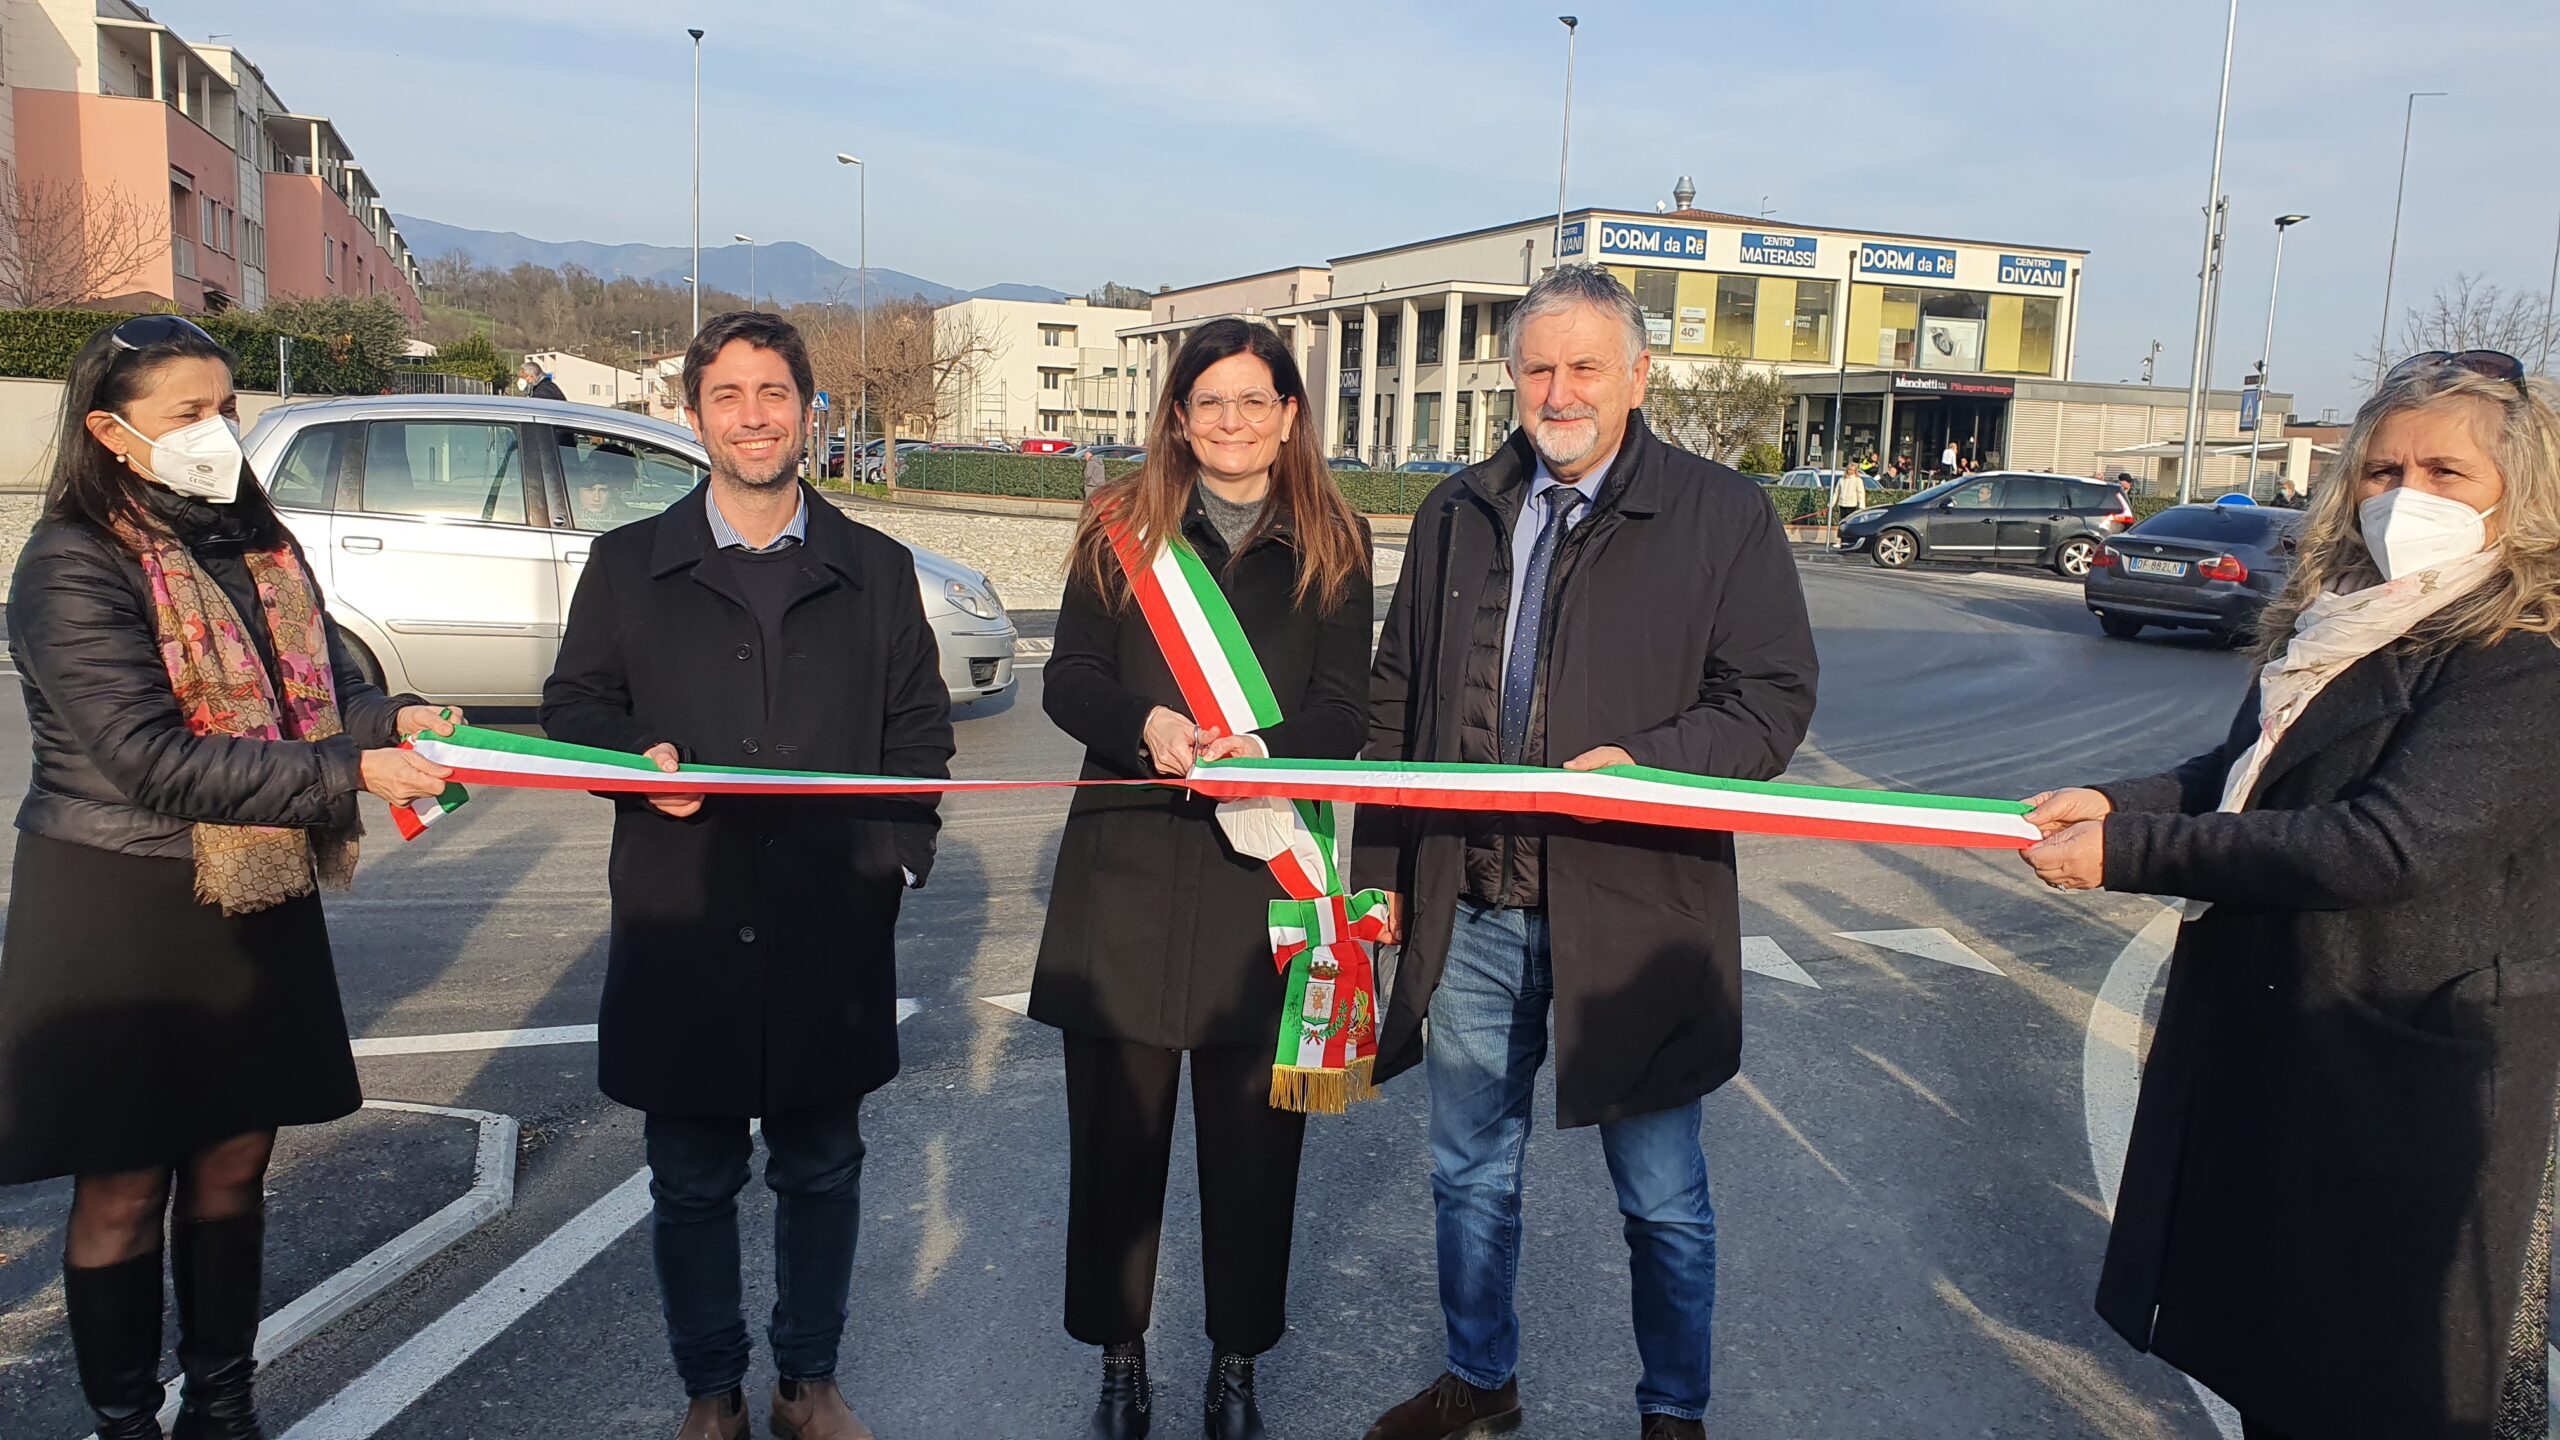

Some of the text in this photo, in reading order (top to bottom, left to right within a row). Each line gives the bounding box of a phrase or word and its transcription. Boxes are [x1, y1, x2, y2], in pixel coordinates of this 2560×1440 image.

[1602, 228, 1660, 251] DORMI
[1664, 237, 1680, 253] da
[1762, 236, 1795, 247] CENTRO
[1741, 247, 1815, 266] MATERASSI
[1862, 248, 1913, 271] DORMI
[1917, 256, 1932, 272] da
[2015, 257, 2050, 268] CENTRO
[2001, 266, 2062, 286] DIVANI
